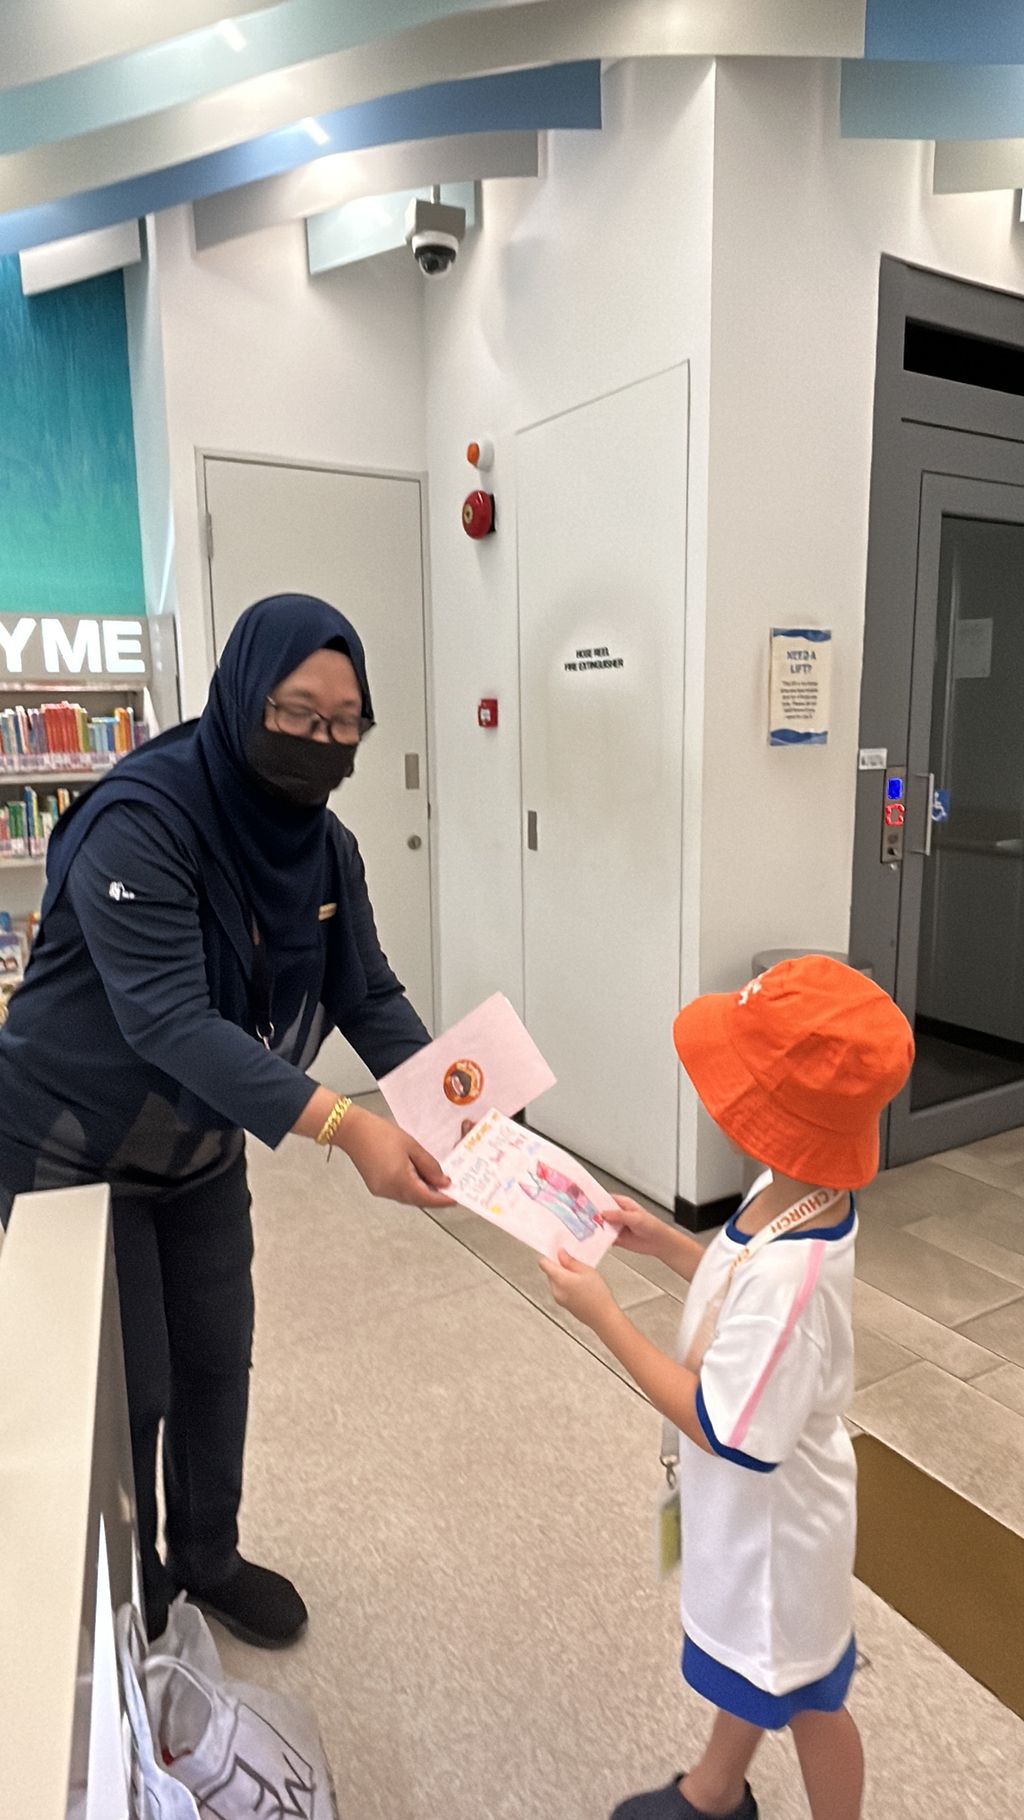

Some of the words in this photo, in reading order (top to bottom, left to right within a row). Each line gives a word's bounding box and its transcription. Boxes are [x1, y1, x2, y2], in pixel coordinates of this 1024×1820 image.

[0, 618, 146, 673] YME
[564, 662, 577, 671] FIRE
[578, 658, 624, 671] EXTINGUISHER
[770, 1190, 829, 1234] CHURCH
